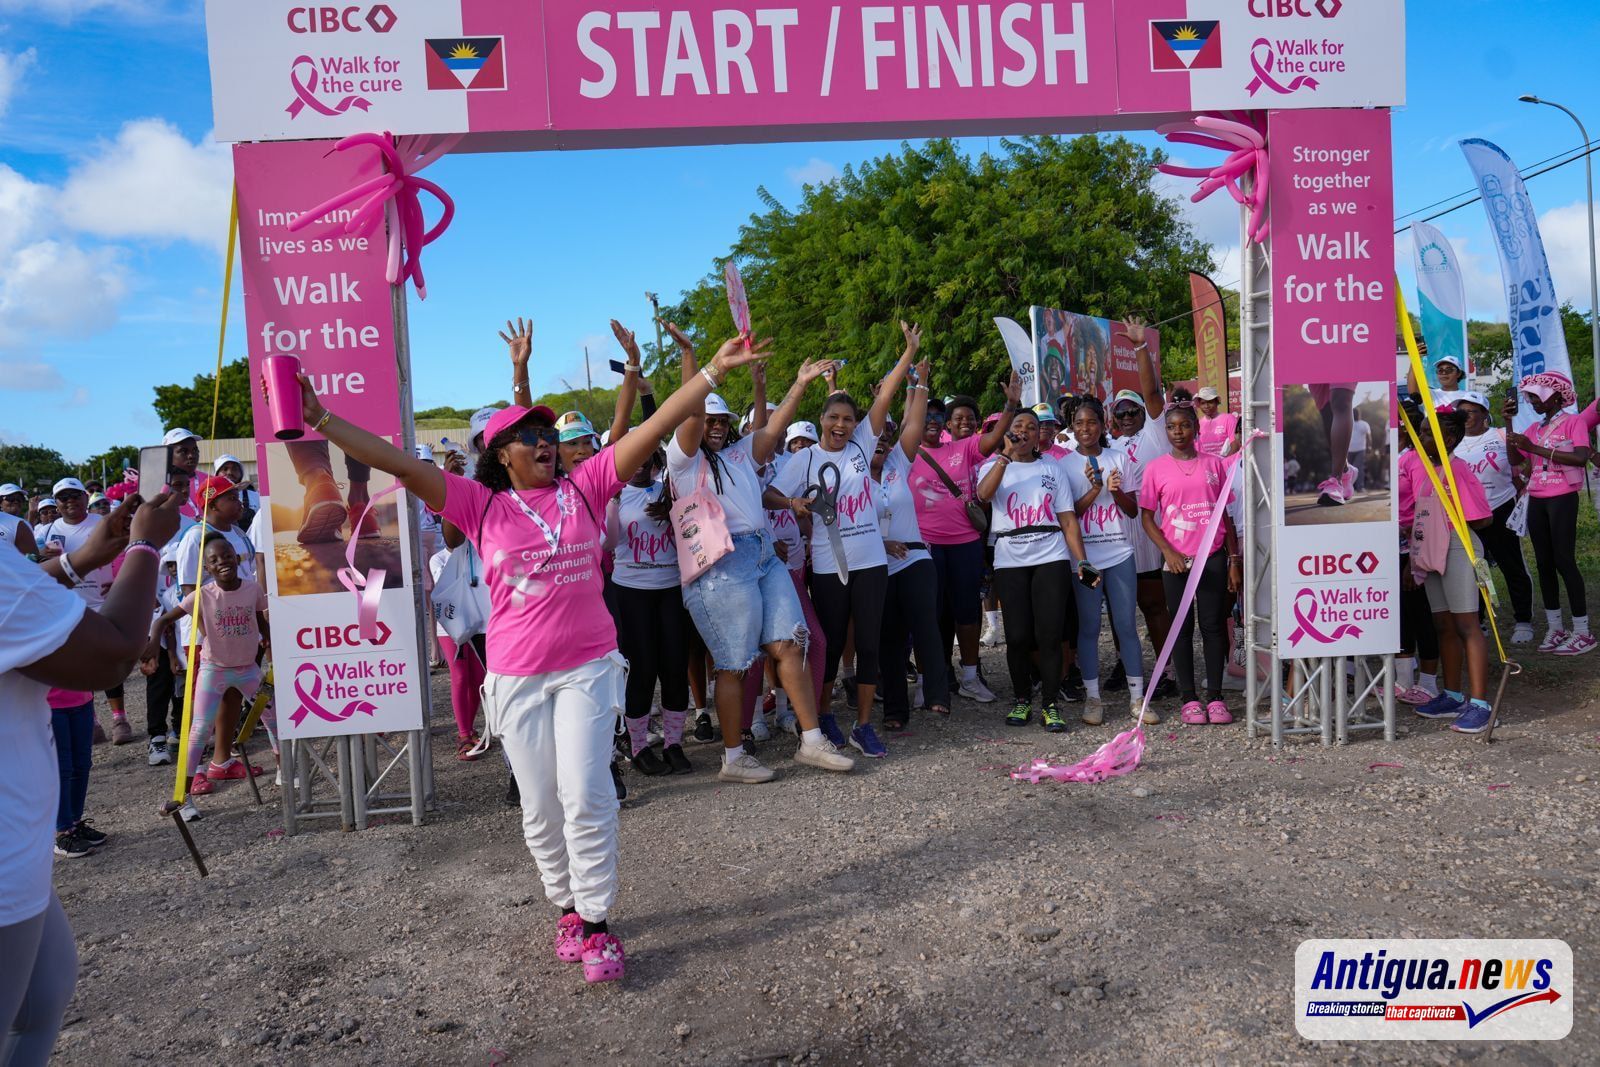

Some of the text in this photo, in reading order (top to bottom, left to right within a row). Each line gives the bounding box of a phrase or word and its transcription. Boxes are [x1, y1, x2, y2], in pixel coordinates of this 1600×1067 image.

[287, 4, 362, 33] CIBC
[1247, 0, 1312, 18] CIBC
[576, 8, 799, 98] START
[861, 2, 1089, 90] FINISH
[1276, 38, 1344, 56] Walk for
[320, 55, 401, 75] Walk for
[1276, 56, 1346, 73] the cure
[322, 75, 403, 94] the cure
[1293, 145, 1370, 166] Stronger
[1293, 173, 1371, 194] together
[1308, 202, 1357, 216] as we
[258, 236, 369, 255] lives as we
[1297, 232, 1371, 261] Walk
[273, 272, 362, 305] Walk
[1284, 274, 1384, 303] for the
[261, 318, 380, 352] for the
[1300, 317, 1370, 345] Cure
[301, 367, 365, 396] ure
[1298, 554, 1353, 576] CIBC
[1320, 586, 1389, 604] Walk for
[1320, 606, 1389, 623] the cure
[296, 624, 361, 650] CIBC
[324, 659, 406, 681] Walk for
[325, 681, 408, 700] the cure
